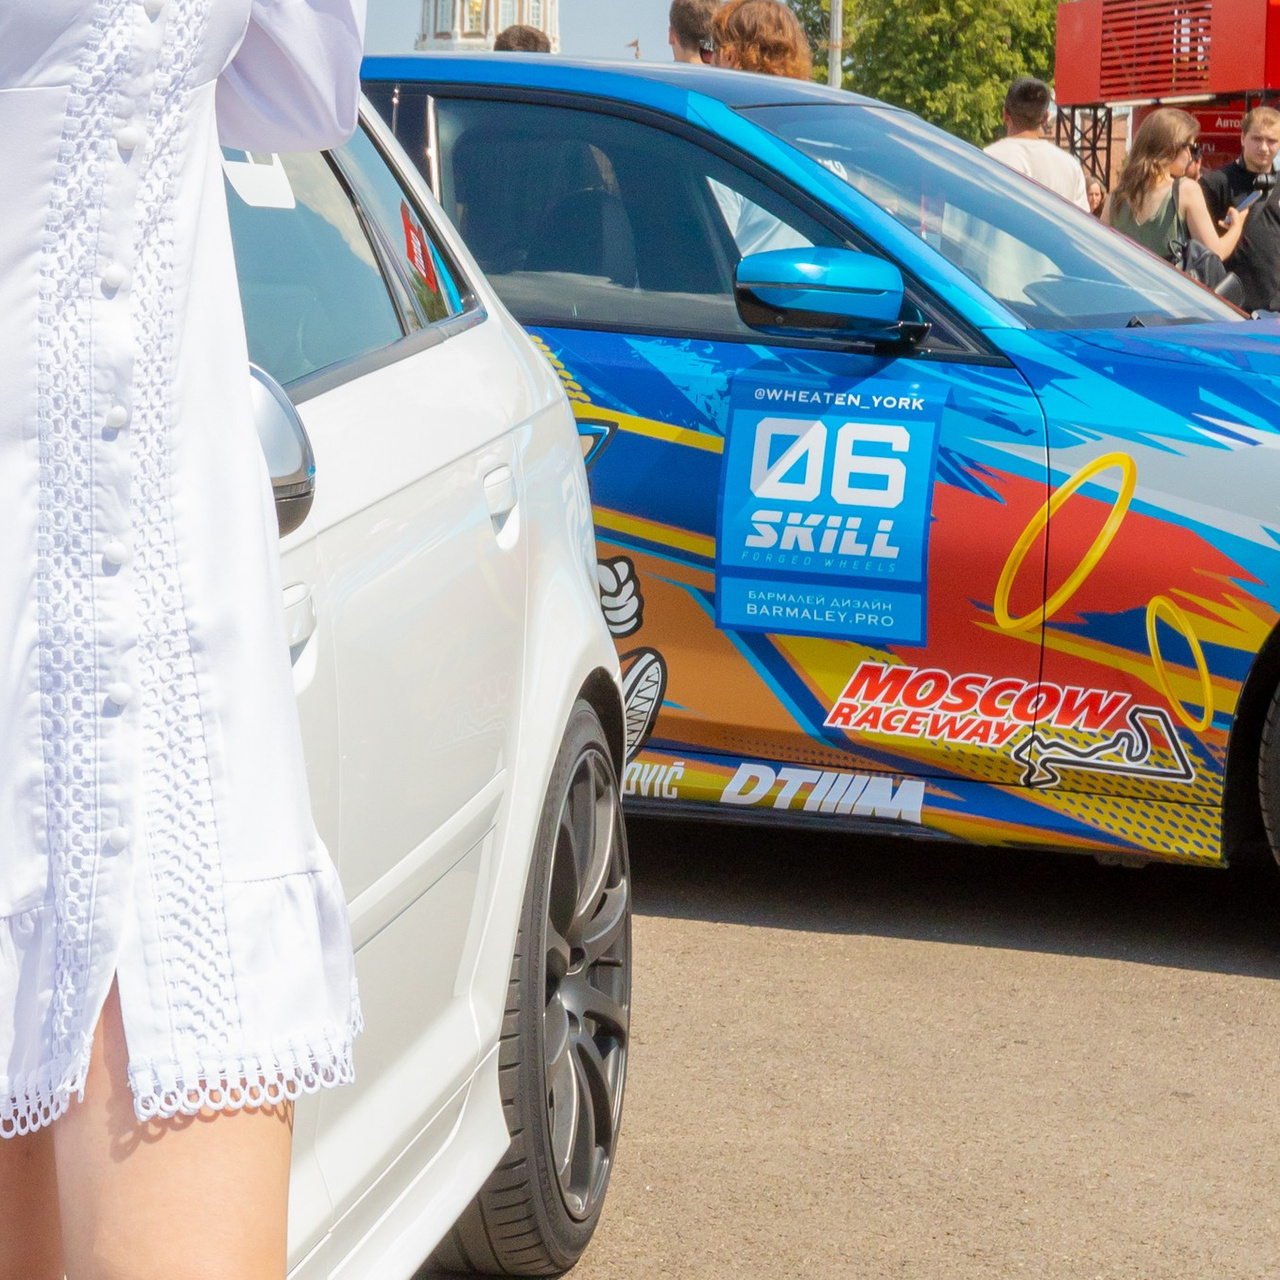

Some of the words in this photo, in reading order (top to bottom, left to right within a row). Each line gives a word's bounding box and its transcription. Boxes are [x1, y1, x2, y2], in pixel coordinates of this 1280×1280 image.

[1215, 116, 1241, 128] Авто
[754, 388, 925, 411] @WHEATEN_YORK
[750, 417, 910, 508] 06
[741, 551, 812, 566] FORGED
[824, 558, 896, 573] WHEELS
[748, 590, 825, 605] БАРМАЛЕЙ
[830, 597, 892, 612] ДИЗАЙН
[746, 603, 894, 627] BARMALEY.PRO
[838, 660, 1132, 731] MOSCOW
[823, 699, 1026, 747] RACEWAY
